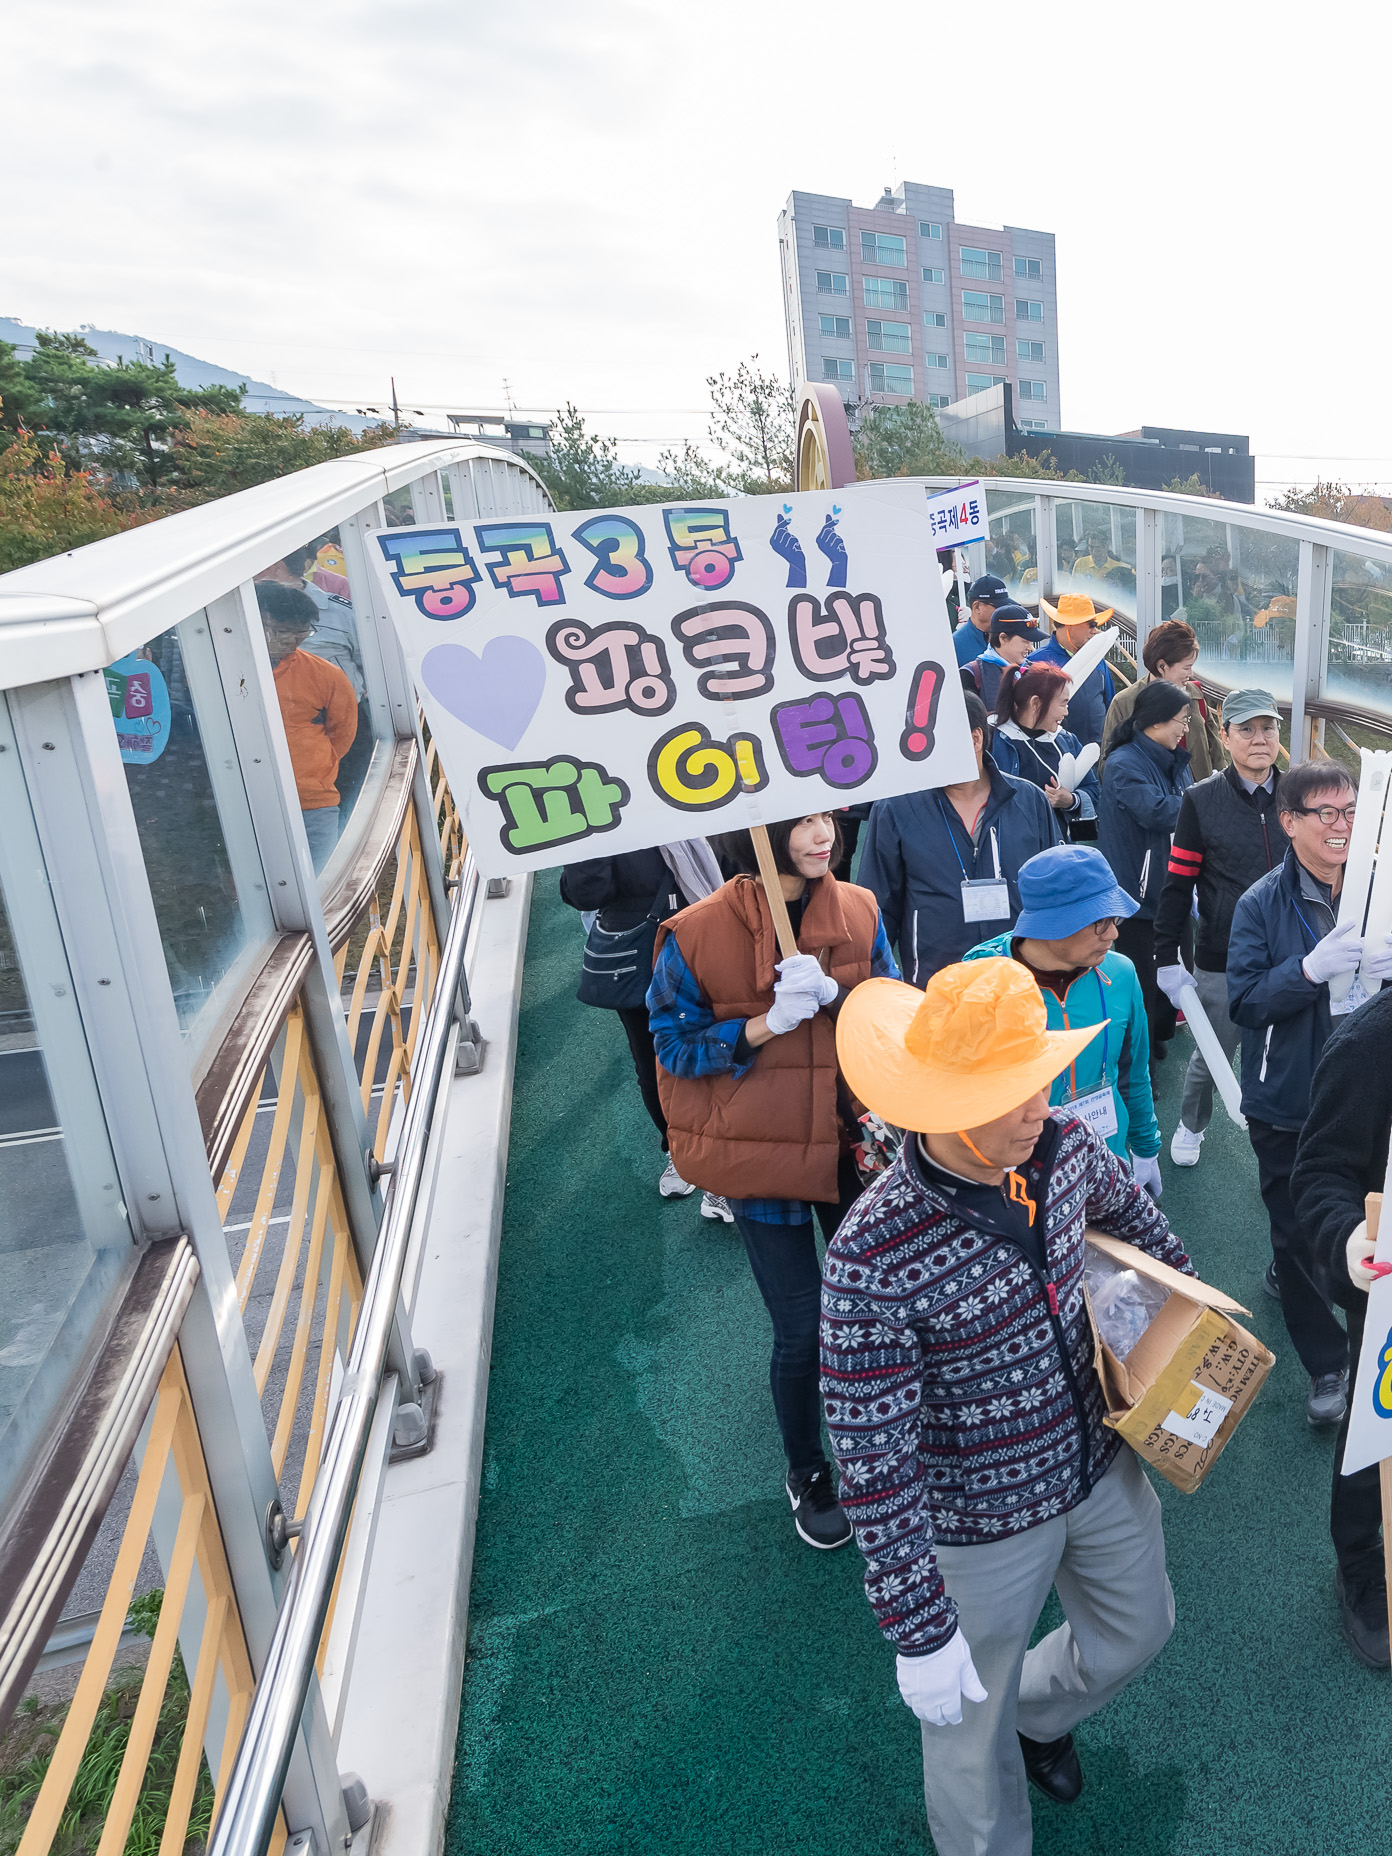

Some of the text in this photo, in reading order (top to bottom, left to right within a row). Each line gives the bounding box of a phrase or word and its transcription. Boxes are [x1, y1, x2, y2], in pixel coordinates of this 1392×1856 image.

[545, 590, 898, 717] 핑크빛
[477, 660, 945, 855] 파이팅!
[1228, 1348, 1250, 1376] QTY:
